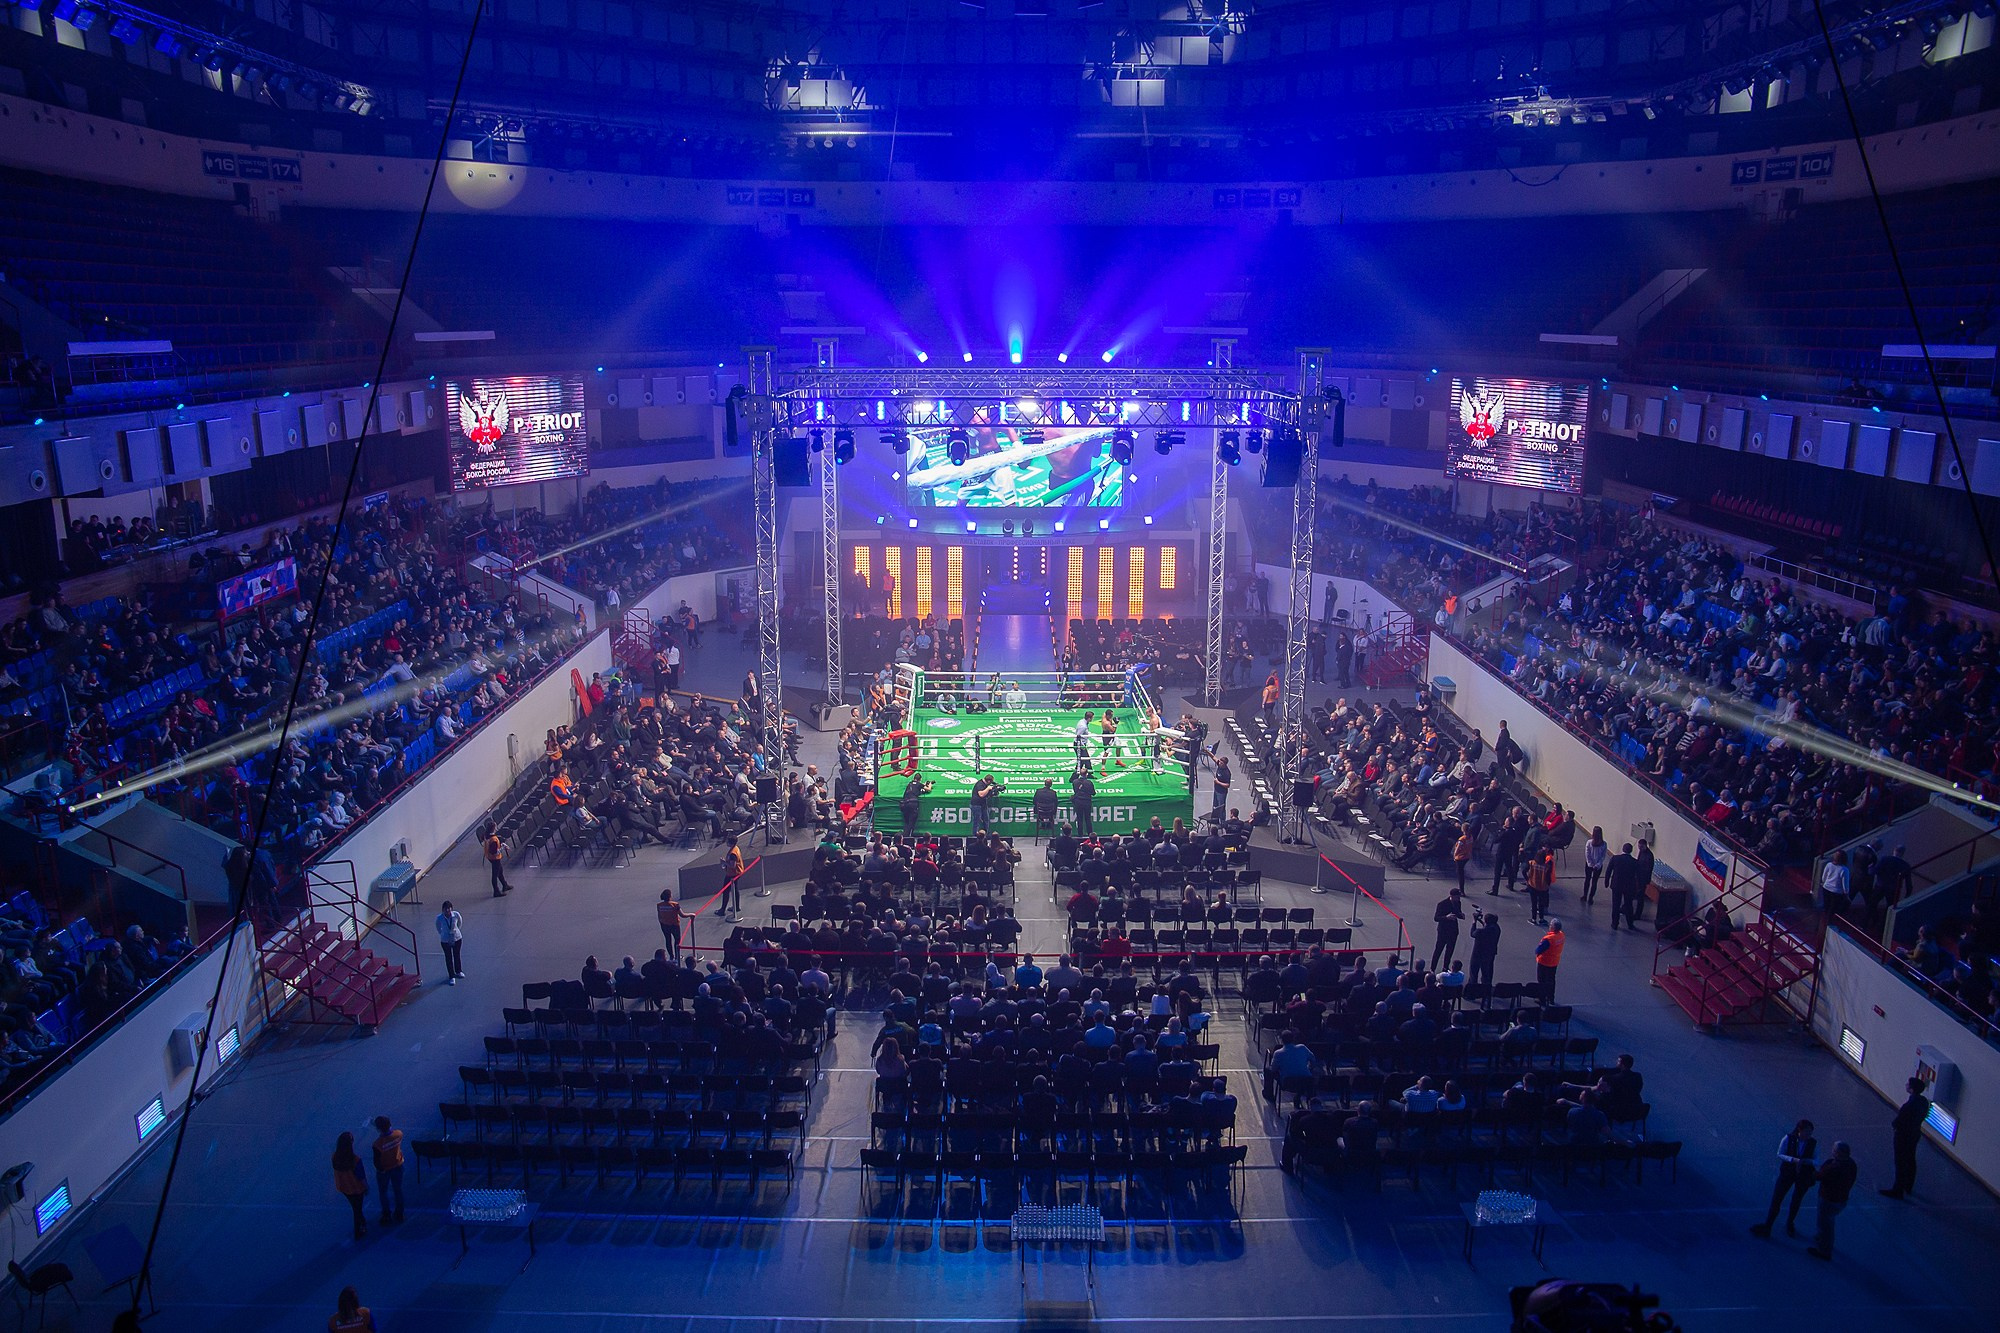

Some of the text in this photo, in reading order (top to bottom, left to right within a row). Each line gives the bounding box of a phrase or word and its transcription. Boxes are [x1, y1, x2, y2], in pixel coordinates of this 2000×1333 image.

[214, 158, 234, 172] 16
[272, 163, 291, 177] 17
[1802, 158, 1823, 173] 10
[1745, 166, 1757, 178] 9
[736, 191, 754, 202] 17
[534, 433, 565, 444] BOXING
[1526, 441, 1559, 453] BOXING
[469, 459, 506, 470] ФЕДЕРАЦИЯ
[1462, 454, 1495, 465] ФЕДЕРАЦИЯ
[1457, 460, 1498, 472] БОКСА РОССИИ
[466, 466, 511, 479] БОКСА РОССИИ
